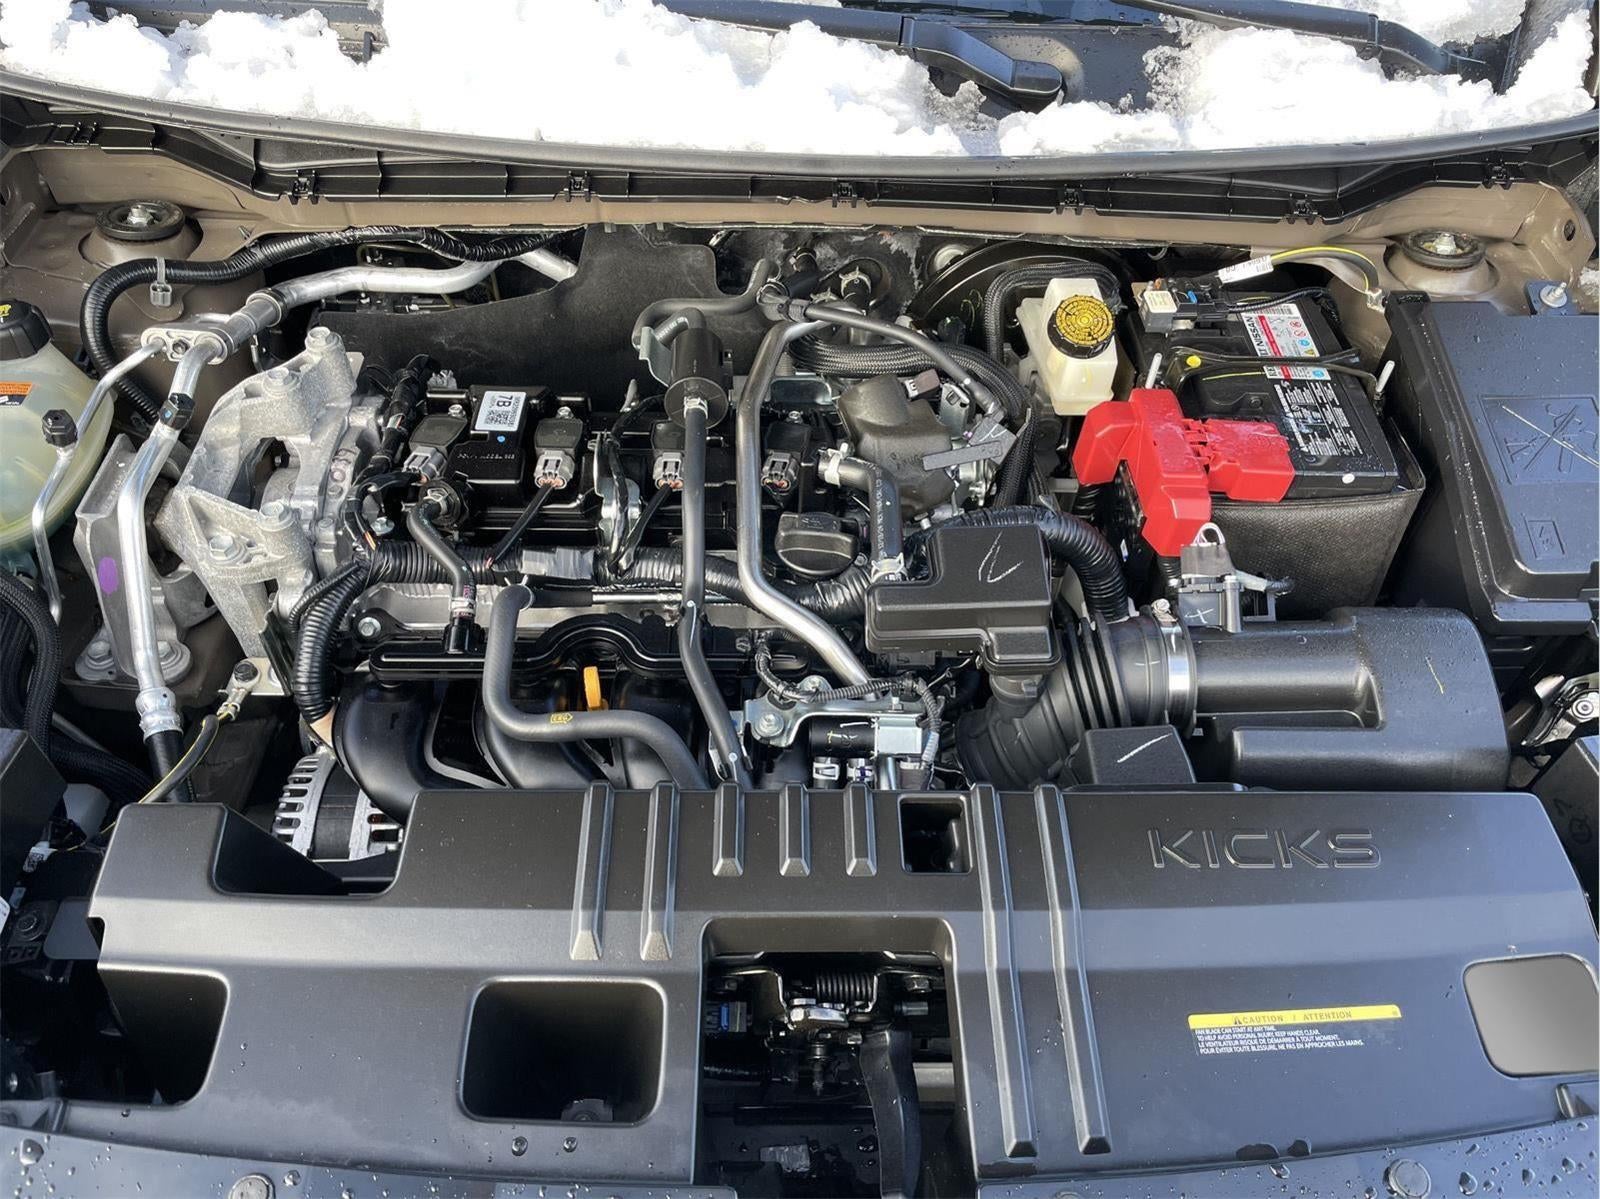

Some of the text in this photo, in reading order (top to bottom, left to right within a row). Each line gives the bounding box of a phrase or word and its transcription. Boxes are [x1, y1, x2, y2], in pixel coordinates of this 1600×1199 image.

[1245, 315, 1264, 347] NISSAN
[496, 395, 513, 408] 7B
[1148, 829, 1381, 868] KICKS
[1242, 1015, 1283, 1024] CAUTION
[1304, 1011, 1352, 1021] ATTENTION
